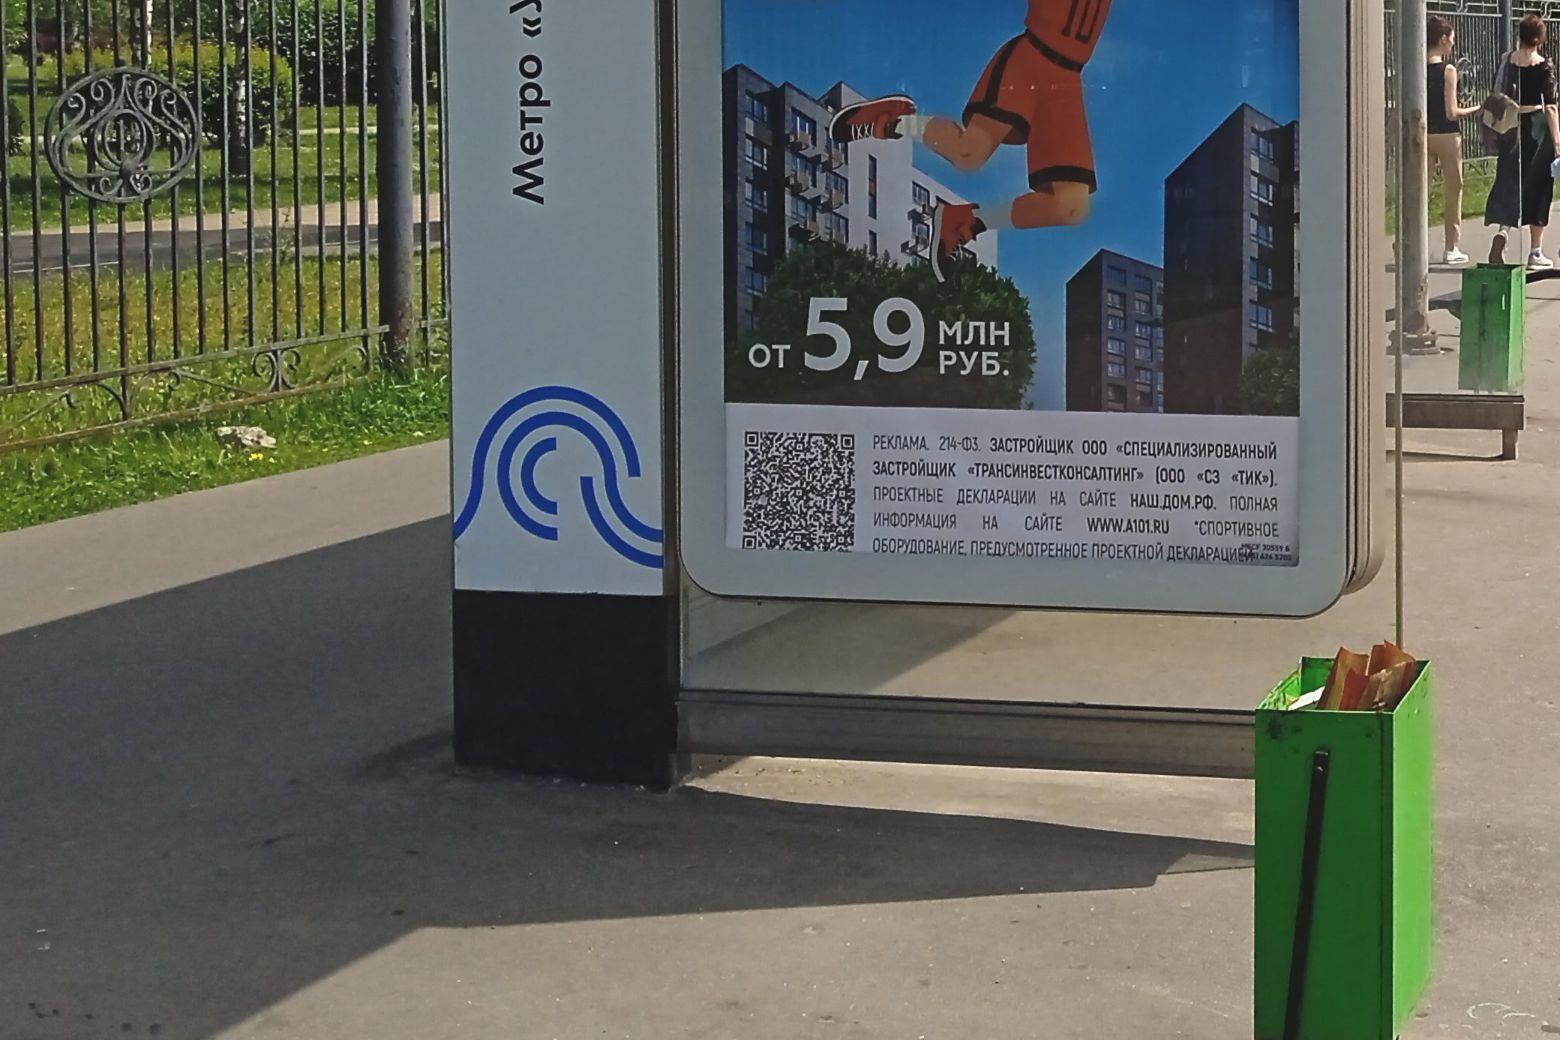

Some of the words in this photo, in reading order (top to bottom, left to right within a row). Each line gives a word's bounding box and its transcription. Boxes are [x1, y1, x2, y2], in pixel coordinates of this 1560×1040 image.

[512, 54, 551, 205] Метро
[804, 297, 925, 381] 5,9
[938, 320, 1010, 346] МЛН
[939, 350, 1010, 376] РУБ.
[872, 435, 930, 451] РЕКЛАМА.
[989, 435, 1074, 455] ЗАСТРОЙЩИК
[1082, 440, 1107, 455] ООО
[1116, 441, 1277, 459] «СПЕЦИАЛИЗИРОВАННЫЙ
[872, 459, 956, 479] ЗАСТРОЙЩИК
[968, 462, 1144, 482] «ТРАНСИНВЕСТКОНСАЛТИНГ»
[873, 486, 943, 503] ПРОЕКТНЫЕ
[956, 488, 1036, 506] ДЕКЛАРАЦИИ
[1050, 491, 1066, 506] НА
[1079, 489, 1116, 507] САЙТЕ
[1130, 493, 1217, 511] НАШ.ДОМ.РФ.
[1230, 495, 1278, 511] ПОЛНАЯ
[873, 512, 957, 530] ИНФОРМАЦИЯ
[982, 516, 998, 530] НА
[1024, 513, 1062, 531] САЙТЕ
[1087, 517, 1170, 534] WWW.A101.RU
[970, 541, 1087, 558] ПРЕДУСМОТРЕННОЕ
[1092, 543, 1163, 560] ПРОЕКТНОЙ
